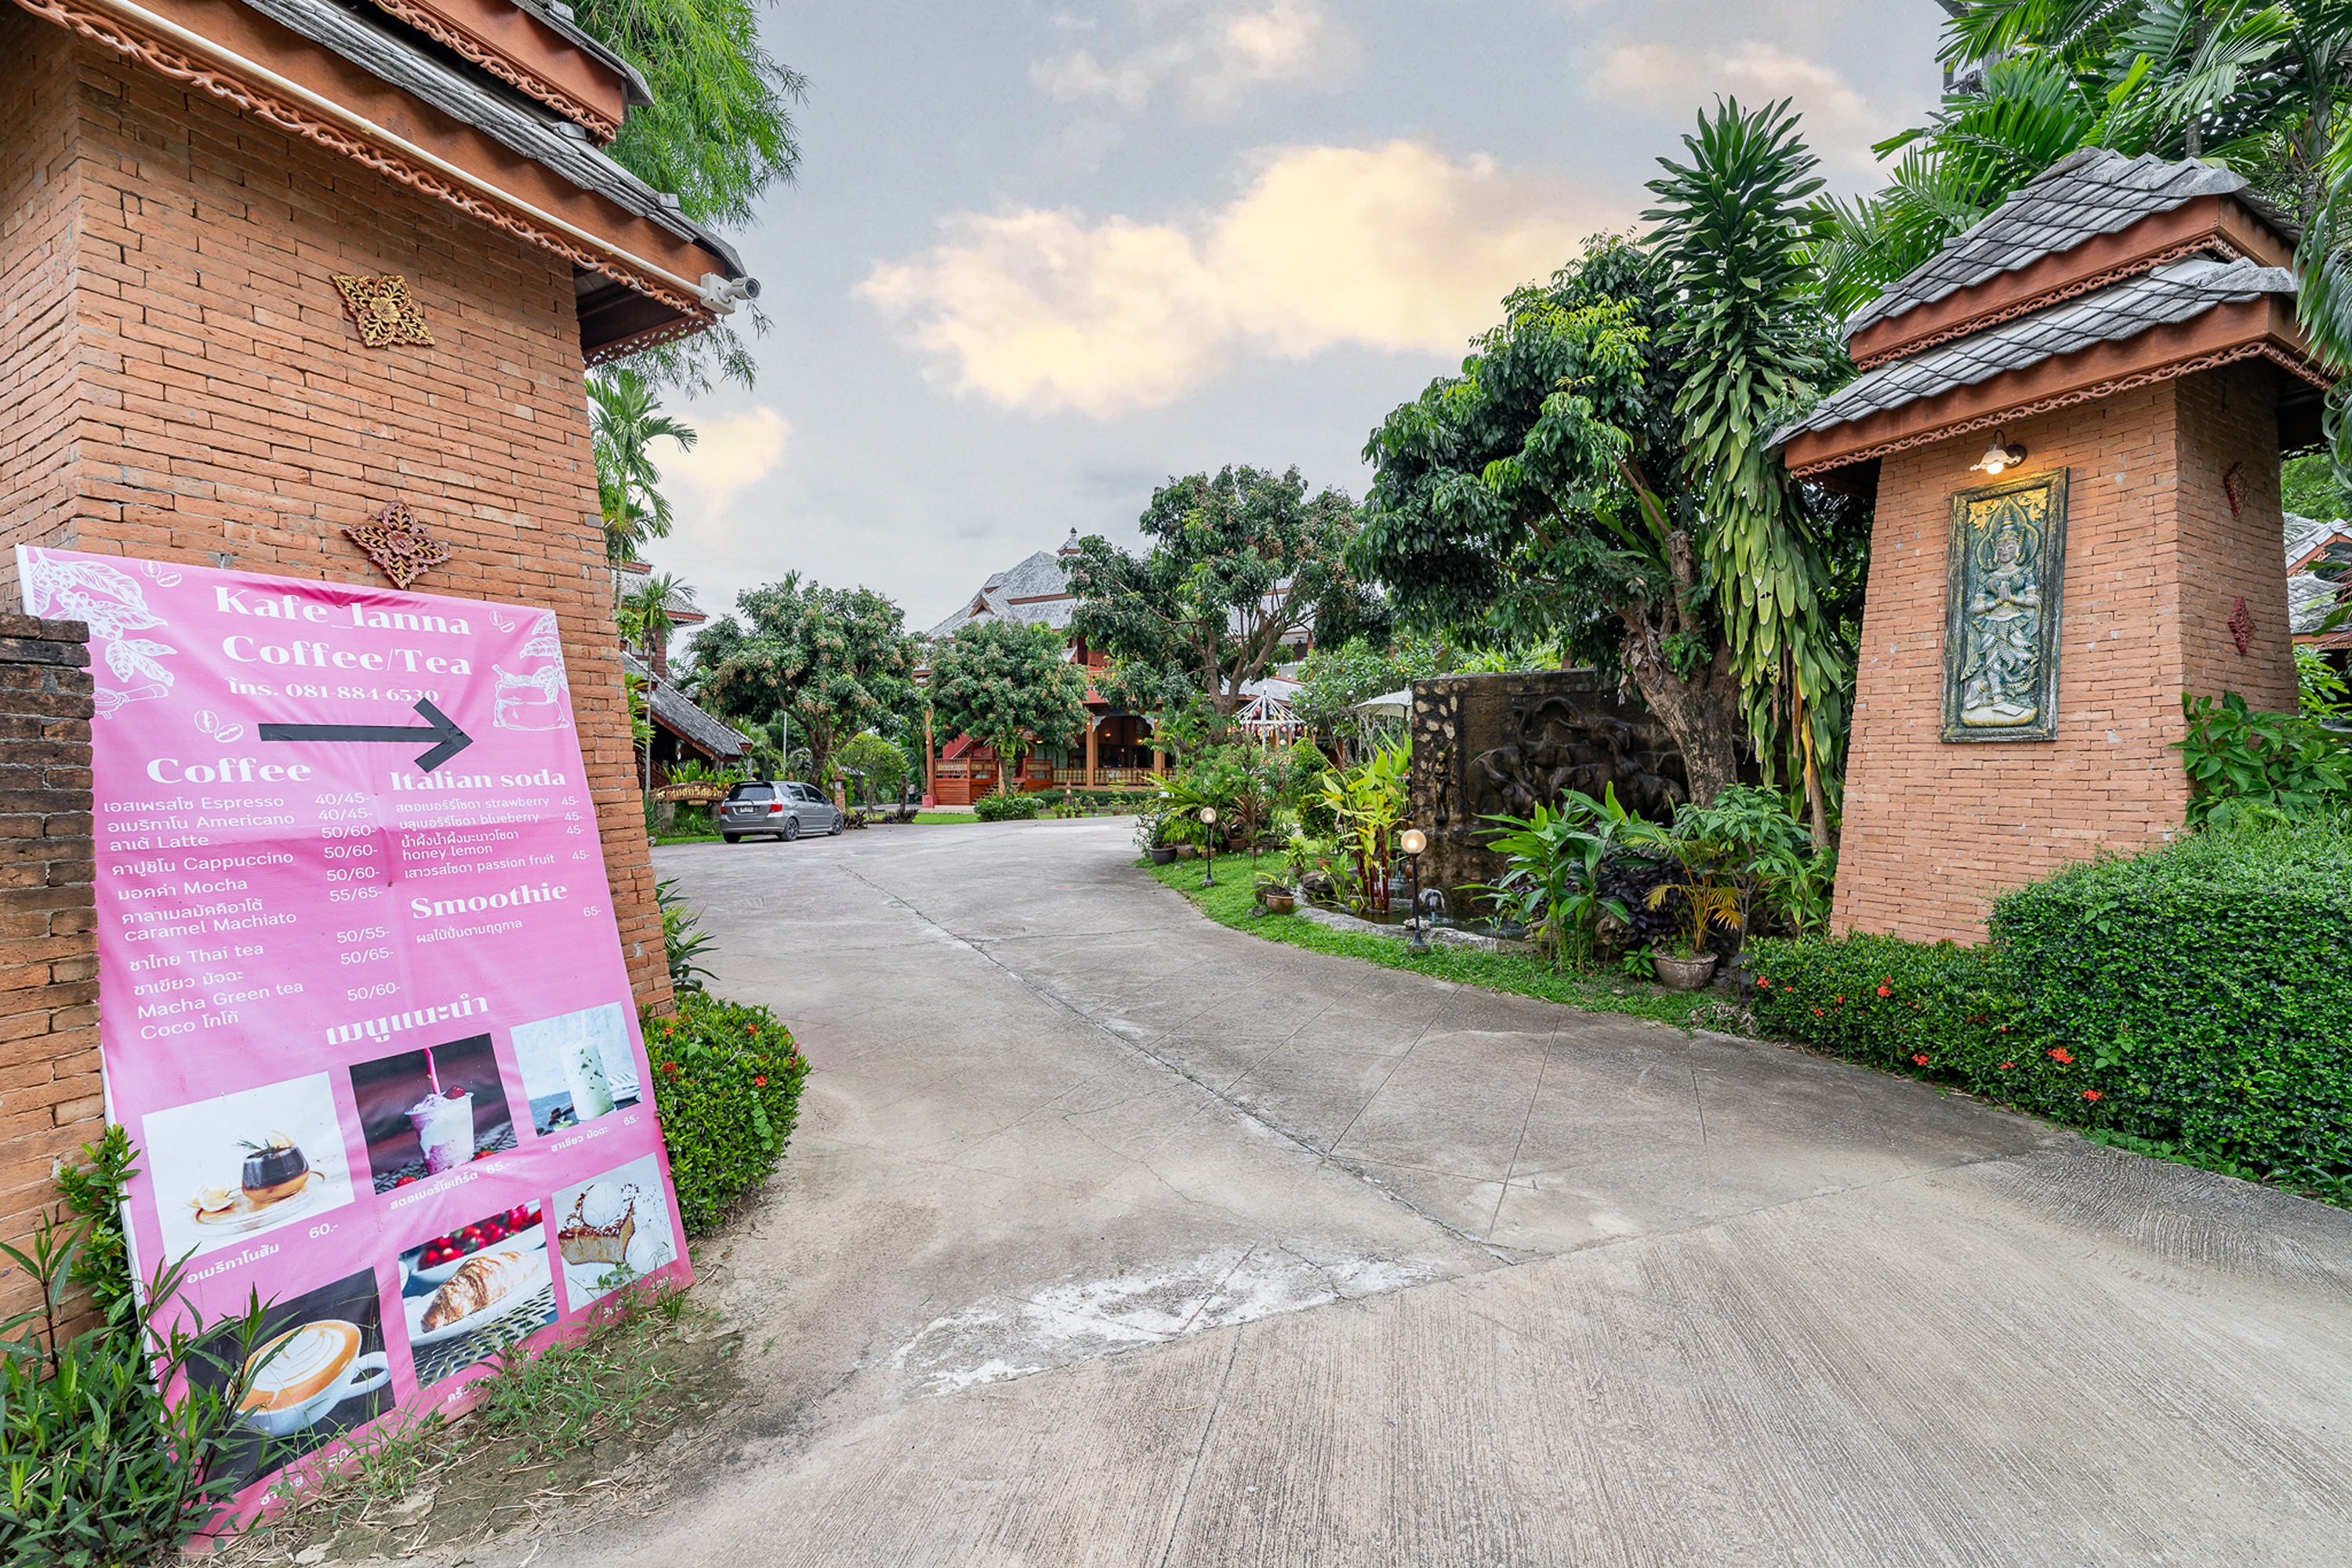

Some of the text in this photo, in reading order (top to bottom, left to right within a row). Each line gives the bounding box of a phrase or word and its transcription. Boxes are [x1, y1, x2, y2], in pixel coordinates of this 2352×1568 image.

[223, 636, 472, 675] Coffee/Tea
[285, 684, 439, 701] 081-884-6530
[147, 757, 313, 783] Coffee
[389, 768, 567, 791] Italian soda
[103, 797, 194, 813] เอสเพรสโซ
[201, 797, 285, 811] Espresso
[485, 797, 550, 809] strawberry
[107, 815, 188, 833] อเมริกาโน
[196, 815, 296, 829] Americano
[480, 813, 539, 826] blueberry
[110, 837, 150, 852] ลาเต้
[158, 835, 210, 849] Latte
[402, 844, 493, 861] honey lemon
[112, 858, 176, 877] คาปูชิโน
[183, 851, 294, 872] Cappuccino
[405, 862, 473, 879] เสาวรสโซดา
[477, 858, 526, 873] passion
[528, 854, 556, 867] fruit
[118, 884, 176, 901] มอคค่า
[183, 878, 248, 895] Mocha
[410, 882, 568, 919] Smoothie
[125, 912, 297, 942] caramel Machiato
[416, 919, 523, 944] ผลไม้ปั่นตามฤดูกาล
[129, 954, 181, 972] ชาไทย
[187, 947, 228, 964] Thai
[234, 945, 264, 958] tea
[132, 977, 195, 996] ชาเขียว
[202, 971, 245, 986] มัจฉะ
[137, 982, 304, 1020] Macha Green tea
[140, 1021, 196, 1040] Coco
[202, 1011, 239, 1029] โกโก้
[325, 993, 490, 1046] เมนูแนะนำ
[186, 1222, 339, 1284] อเมริกาโนส้ม 60.-
